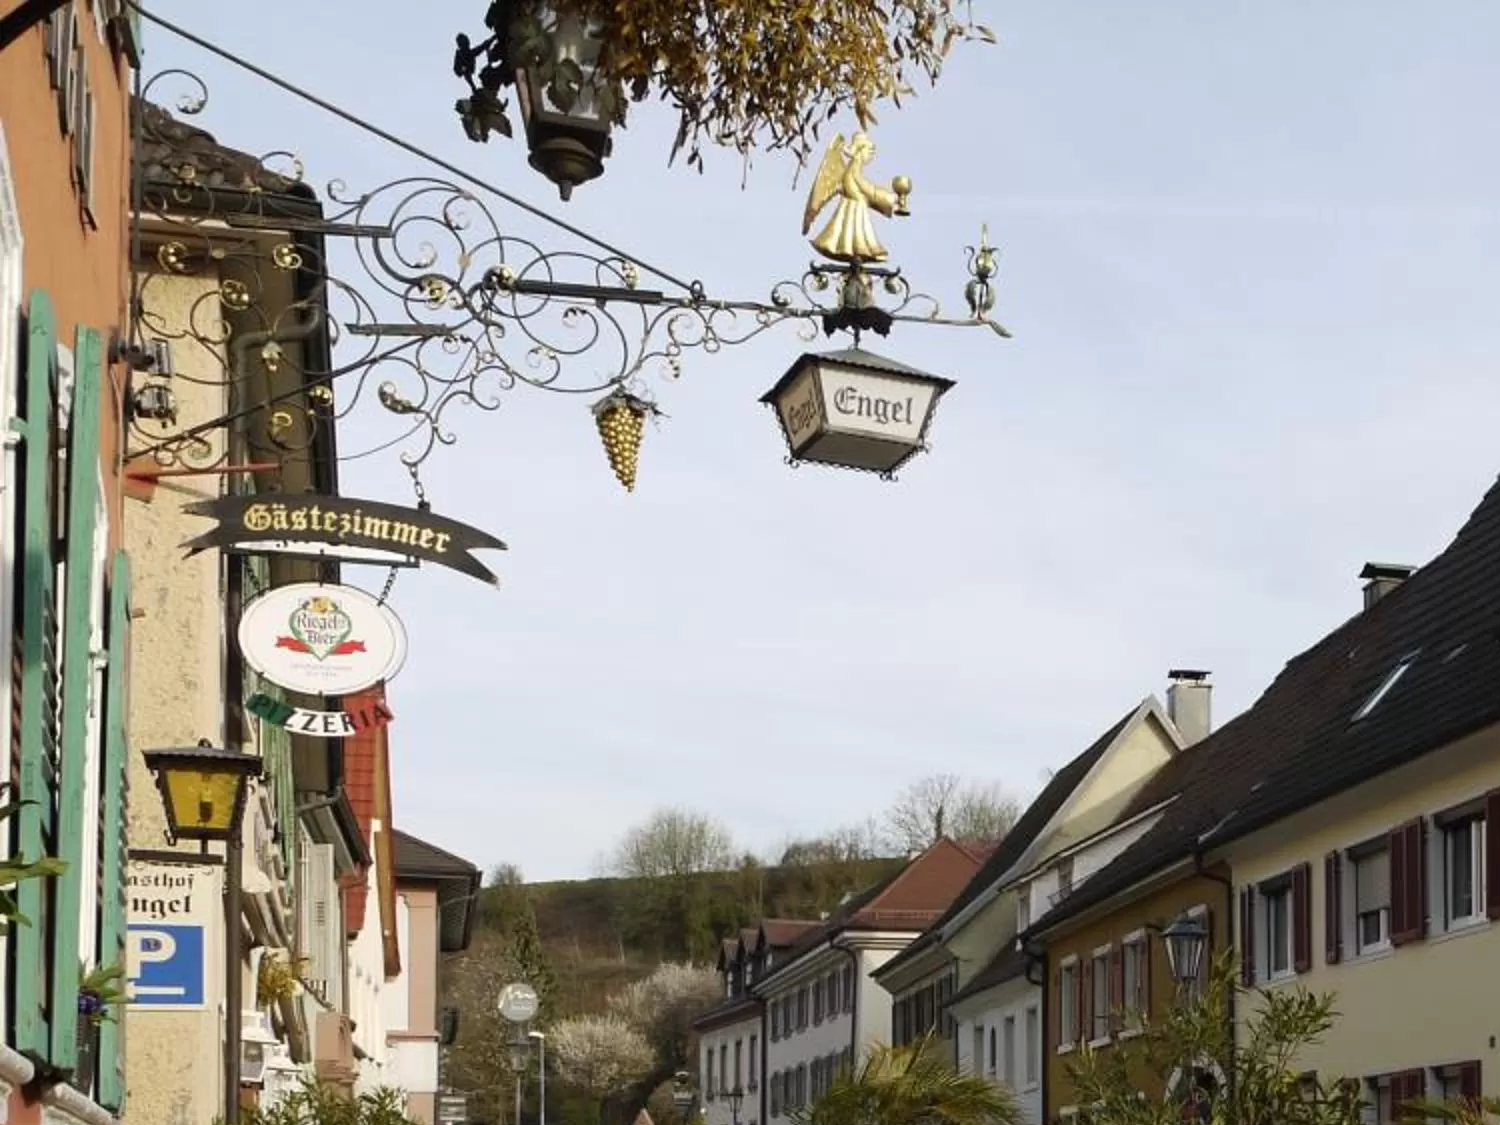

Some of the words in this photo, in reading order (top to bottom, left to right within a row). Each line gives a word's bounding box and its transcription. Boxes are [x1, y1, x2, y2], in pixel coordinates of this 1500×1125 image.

[834, 387, 913, 425] Engel
[243, 502, 451, 552] Gästezimmer
[249, 694, 394, 734] PIZZERIA
[127, 873, 194, 889] asthof
[132, 895, 191, 918] ngel
[127, 929, 176, 979] P
